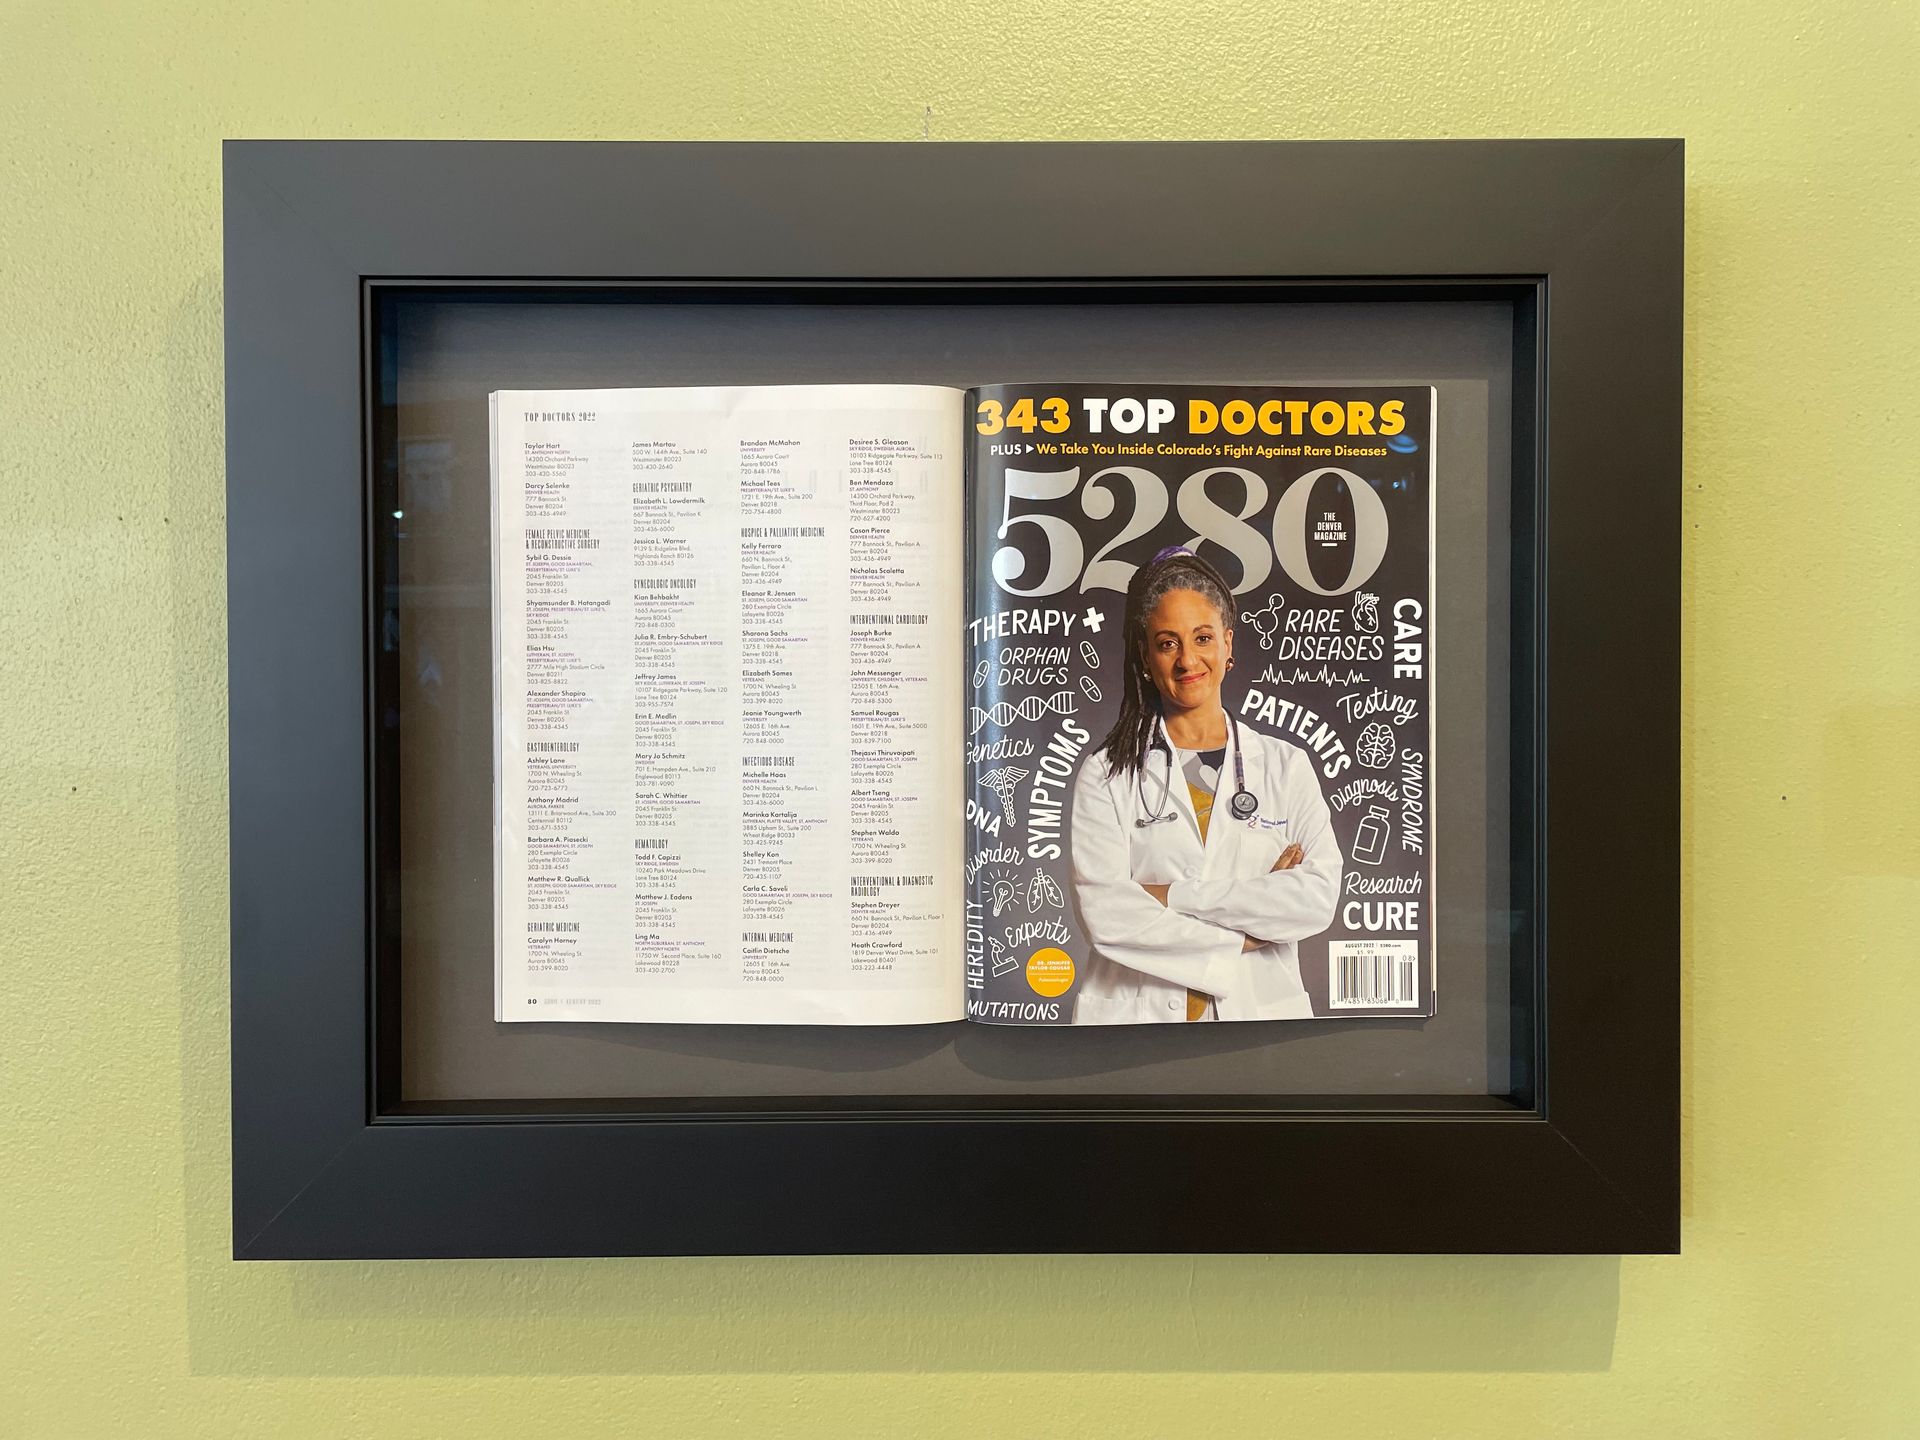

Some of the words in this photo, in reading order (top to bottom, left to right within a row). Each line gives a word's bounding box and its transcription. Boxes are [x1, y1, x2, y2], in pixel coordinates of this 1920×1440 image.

[524, 412, 539, 422] TOP
[542, 412, 576, 422] DOCTORS
[578, 412, 596, 422] 2022
[976, 398, 1070, 434] 343
[1083, 398, 1176, 434] TOP
[1188, 400, 1406, 436] DOCTORS
[991, 444, 1021, 455] PLUS
[1037, 444, 1056, 455] We
[1060, 444, 1089, 455] Take
[1092, 444, 1114, 455] You
[1118, 444, 1154, 455] Inside
[1157, 444, 1221, 456] Colorado's
[1224, 444, 1252, 458] Fight
[1256, 445, 1301, 459] Against
[1304, 445, 1331, 457] Rare
[1335, 445, 1386, 457] Diseases
[525, 483, 545, 491] Darcy
[632, 482, 660, 493] GERIATRIC
[660, 482, 692, 492] PSYCHIATRY
[1324, 512, 1336, 521] THE
[991, 466, 1389, 597] 5280
[1318, 522, 1342, 531] DENVER
[525, 529, 545, 540] FEMALE
[544, 529, 565, 540] PELVIC
[564, 529, 590, 540] MEDICINE
[741, 528, 762, 538] HOSPICE
[764, 528, 768, 537] &
[769, 527, 799, 537] PALLIATIVE
[800, 527, 825, 537] MEDICINE
[1314, 532, 1347, 541] MAGAZINE
[525, 538, 531, 549] &
[531, 538, 576, 549] RECONSTRUCTIVE
[577, 538, 600, 549] SURGERY
[741, 543, 759, 551] Kelly
[633, 579, 668, 589] GYNECOLOGIC
[670, 578, 696, 589] ONCOLOGY
[850, 614, 894, 624] INTERVENTIONAL
[896, 614, 928, 624] CARDIOLOGY
[1285, 609, 1344, 633] RARE
[970, 608, 1076, 646] THERAPY
[657, 634, 708, 642] Embry-Schubert
[850, 629, 874, 638] Joseph
[1393, 598, 1422, 679] CARE
[1279, 636, 1384, 661] DISEASES
[999, 647, 1070, 665] ORPHAN
[634, 673, 656, 682] Jeffrey
[998, 667, 1068, 686] DRUGS
[561, 690, 586, 699] Shapiro
[1336, 686, 1418, 724] Testing
[1240, 689, 1352, 779] PATIENTS
[527, 742, 580, 752] GASTROENTEROLOGY
[967, 734, 1035, 764] Genetics
[527, 757, 550, 766] Ashley
[742, 756, 772, 766] INFECTIOUS
[773, 756, 795, 766] DISEASE
[872, 790, 890, 798] Tseng
[1027, 718, 1091, 860] SYMPTOMS
[527, 796, 555, 805] Anthony
[1330, 779, 1399, 813] Diagnosis
[1401, 748, 1424, 855] SYNDROME
[966, 799, 1001, 838] DNA
[851, 830, 877, 838] Stephen
[634, 839, 668, 849] HEMATOLOGY
[657, 854, 681, 862] Capizzi
[850, 876, 895, 887] INTERVENTIONAL
[896, 876, 901, 886] &
[902, 875, 934, 886] DIAGNOSTIC
[1344, 871, 1422, 896] Research
[850, 886, 881, 896] RADIOLOGY
[851, 902, 878, 910] Stephen
[878, 902, 900, 910] Dreyer
[1342, 902, 1419, 931] CURE
[527, 922, 555, 932] GERIATRIC
[556, 922, 580, 932] MEDICINE
[1004, 915, 1071, 948] Experts
[527, 937, 553, 946] Carolyn
[554, 937, 578, 945] Horney
[635, 933, 648, 942] Ling
[742, 932, 767, 942] INTERNAL
[769, 932, 794, 942] MEDICINE
[966, 899, 984, 989] HEREDITY
[967, 1000, 1060, 1021] MUTATIONS
